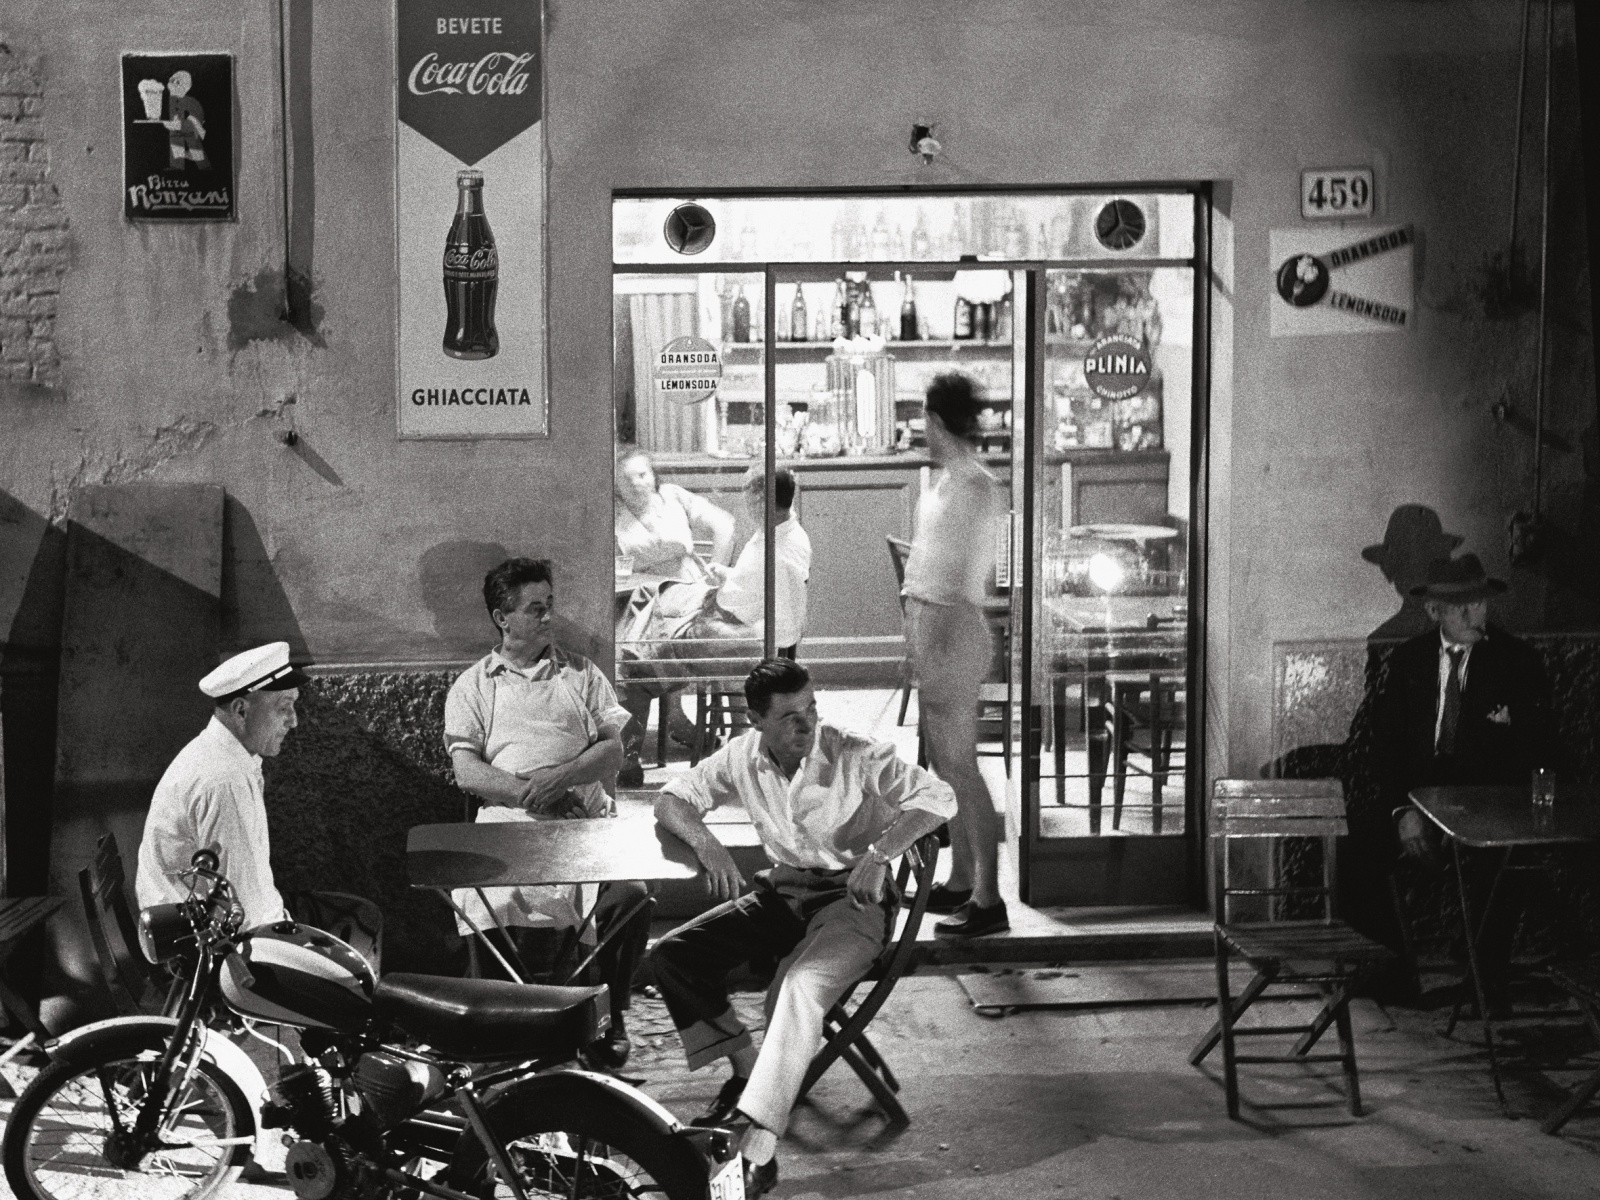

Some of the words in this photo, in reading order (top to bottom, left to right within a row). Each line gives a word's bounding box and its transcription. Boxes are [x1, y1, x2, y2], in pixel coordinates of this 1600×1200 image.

[437, 17, 502, 35] BEVETE
[408, 52, 536, 95] Coca-Cola
[147, 174, 189, 190] Birra
[128, 184, 230, 211] Ronzani
[1308, 177, 1369, 210] 459
[1331, 229, 1408, 267] ORANSODA
[1331, 291, 1407, 325] LEMONSODA
[661, 353, 718, 364] ORANSODA
[1086, 354, 1147, 374] PLINIA
[661, 380, 718, 390] LEMONSODA
[411, 388, 532, 406] GHIACCIATA
